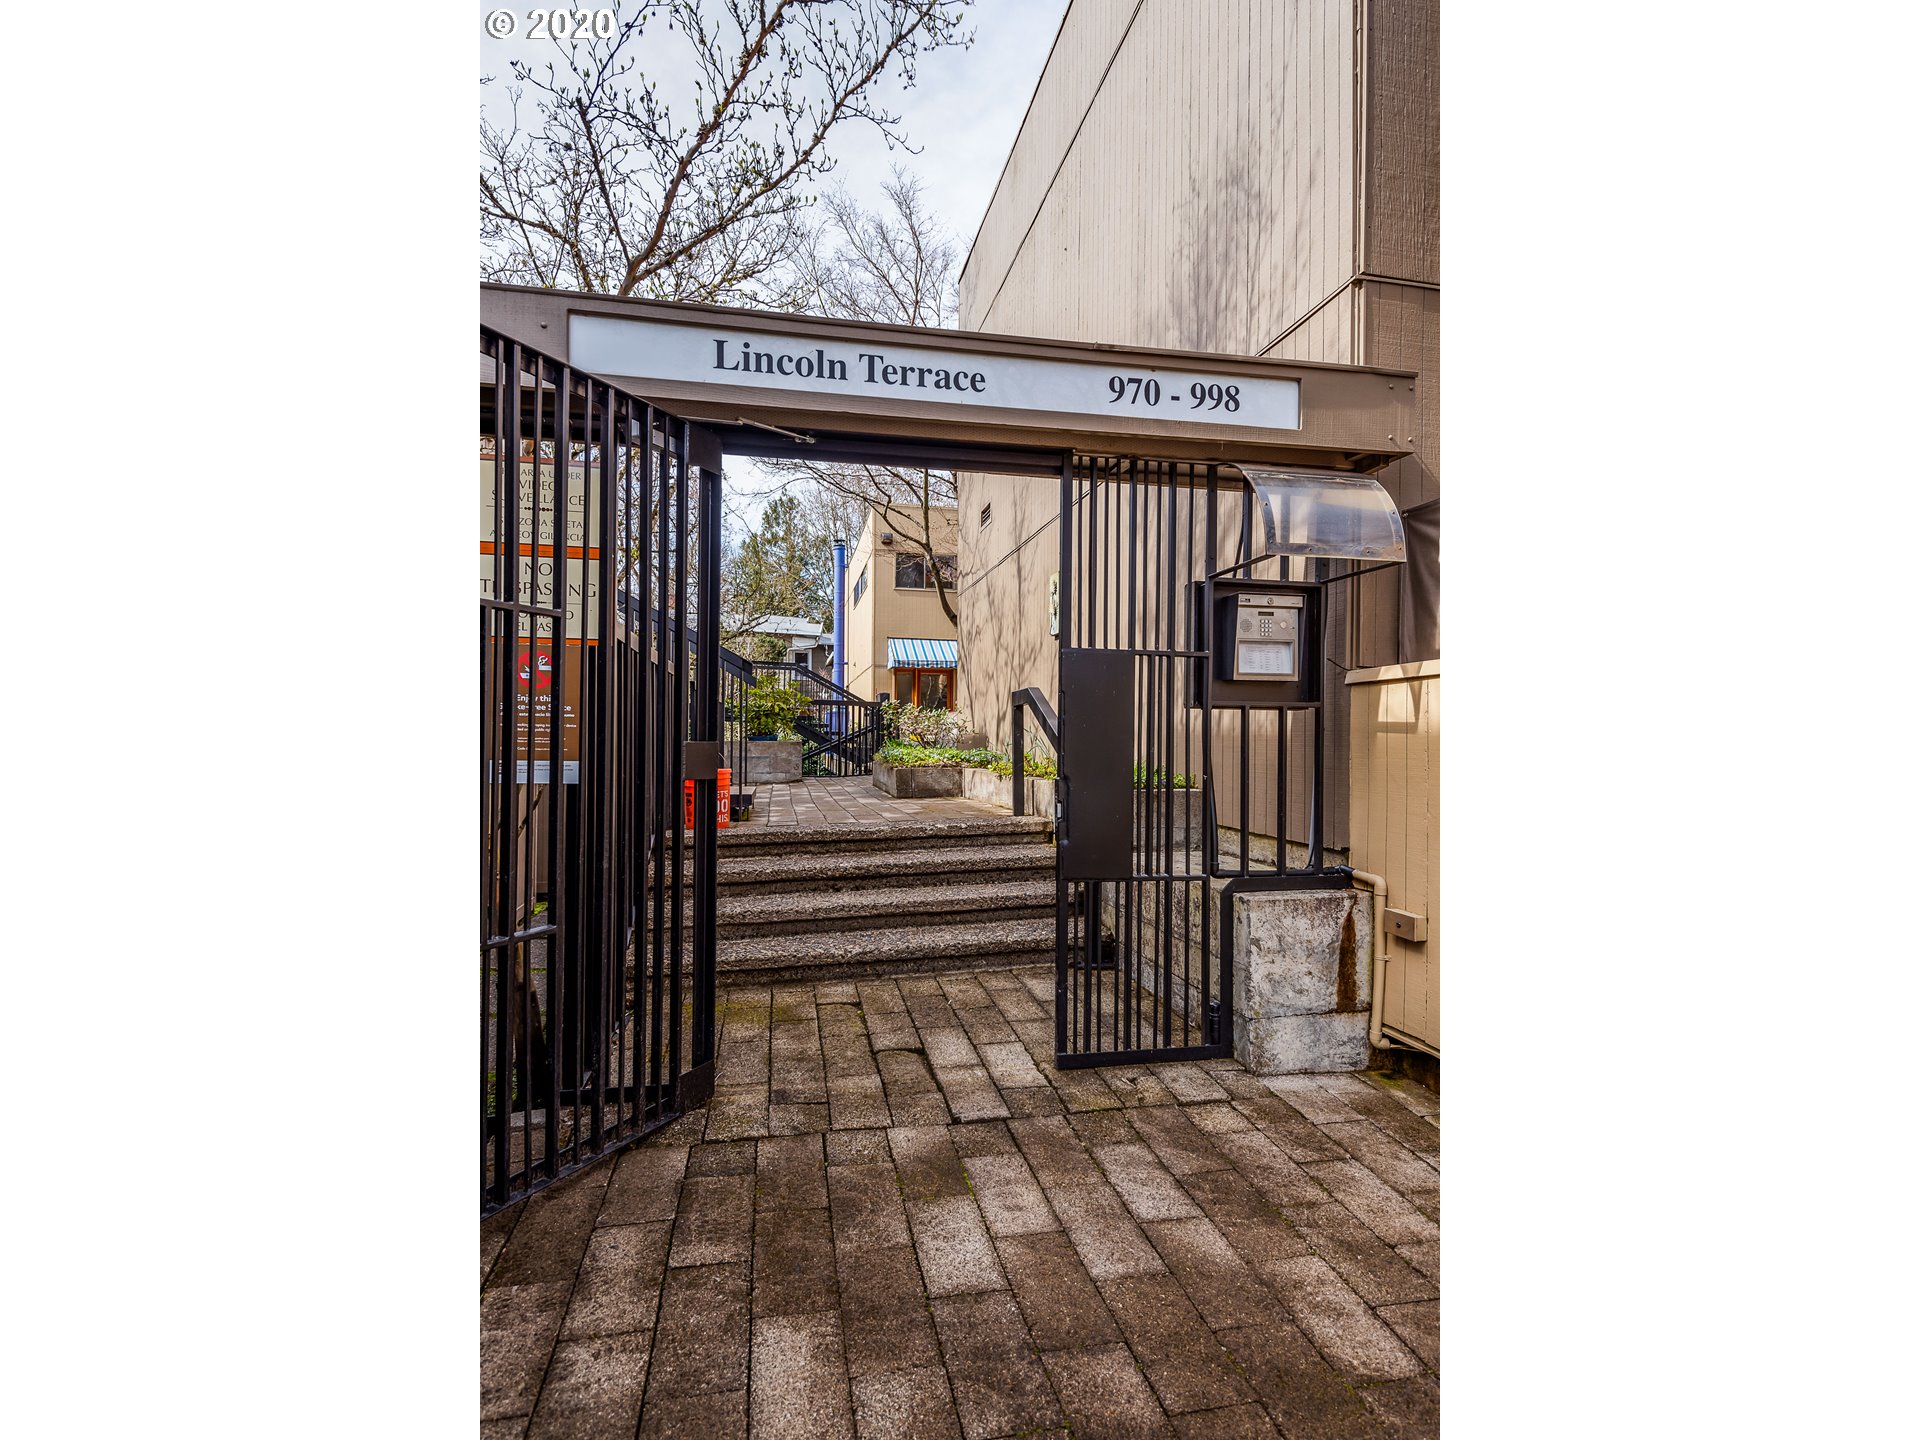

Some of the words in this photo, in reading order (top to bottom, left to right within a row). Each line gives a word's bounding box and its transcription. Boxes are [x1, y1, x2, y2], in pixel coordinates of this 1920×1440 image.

[713, 340, 848, 380] Lincoln
[859, 354, 986, 393] Terrace
[1109, 376, 1161, 406] 970
[1190, 383, 1240, 412] 998
[520, 468, 546, 478] ARA
[519, 518, 548, 527] ZOA
